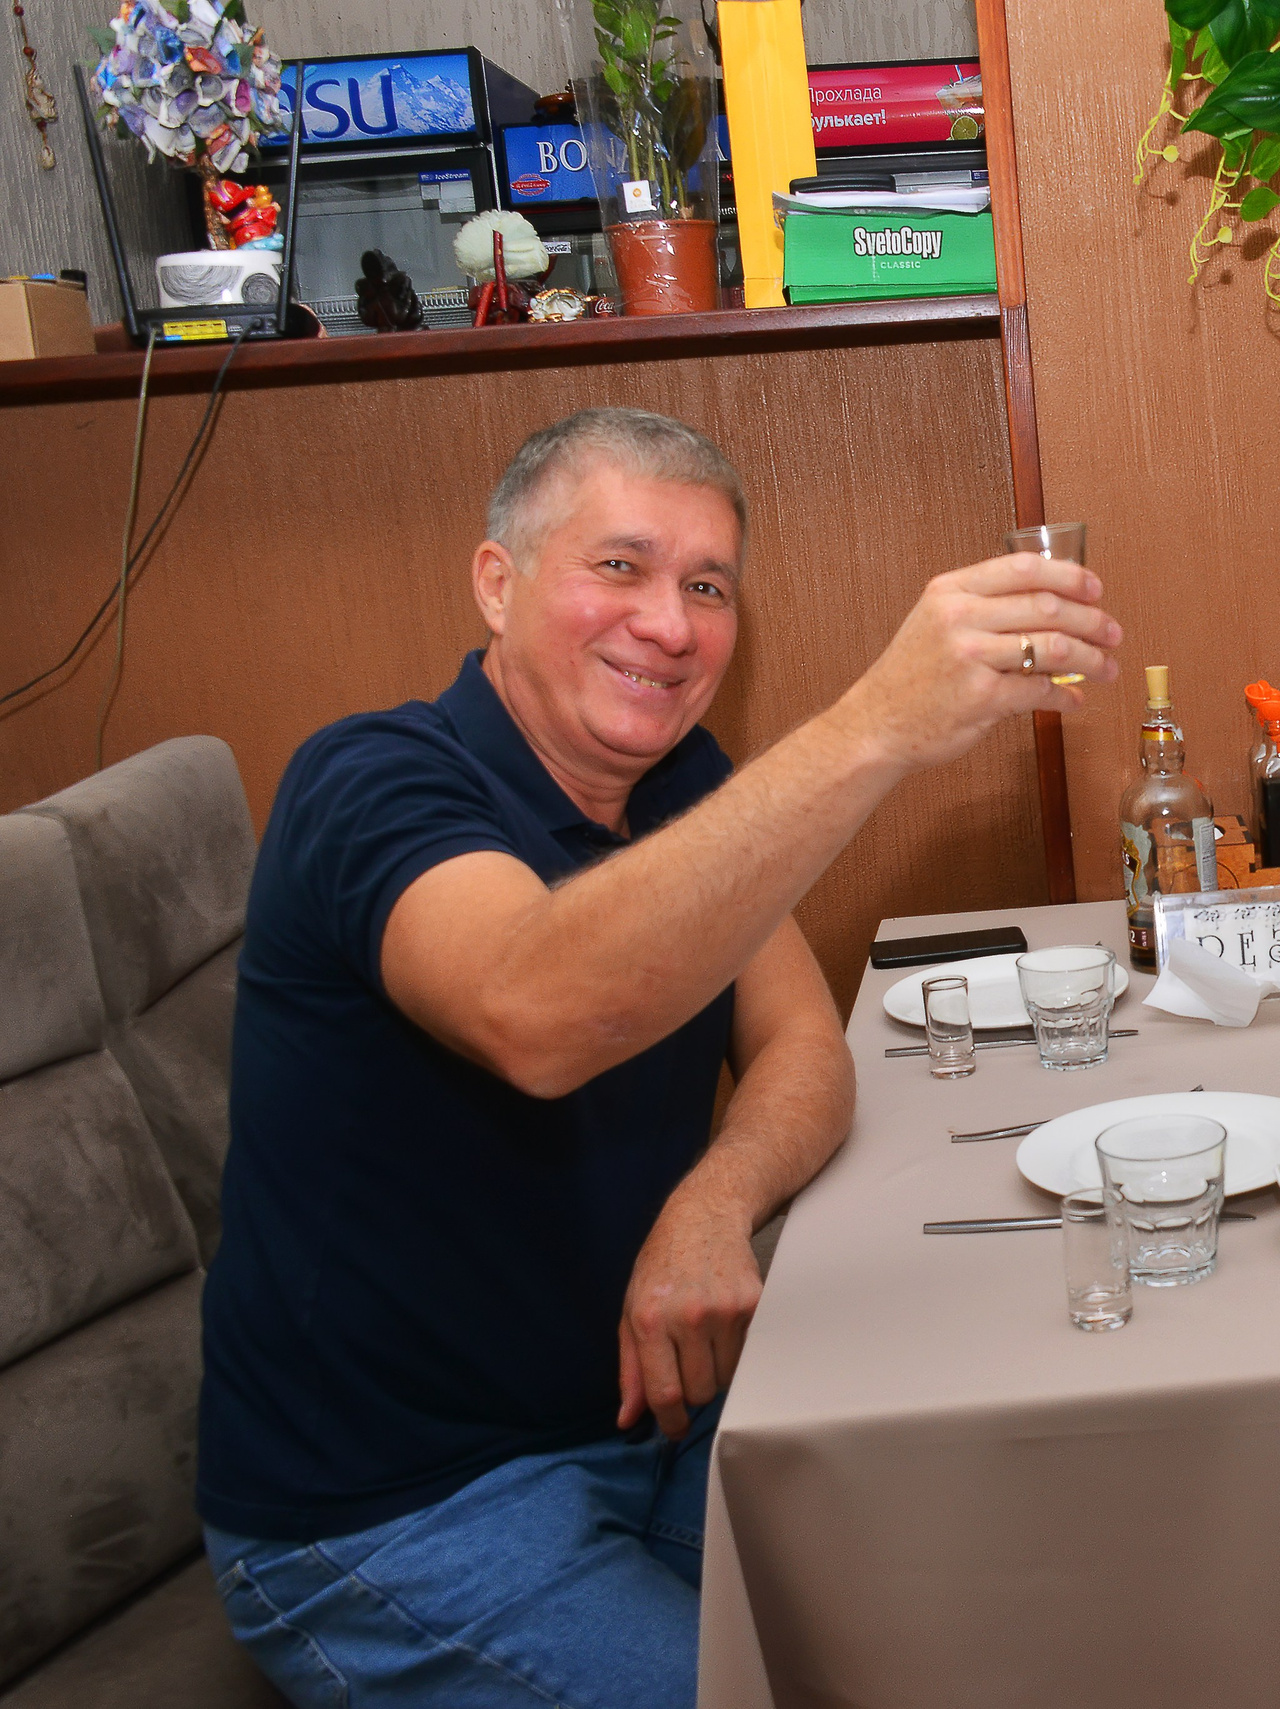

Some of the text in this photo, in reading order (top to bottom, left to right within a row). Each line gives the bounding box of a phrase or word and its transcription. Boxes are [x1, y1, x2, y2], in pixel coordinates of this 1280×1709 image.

[808, 87, 882, 106] Прохлада
[853, 226, 943, 259] SvetoCopy
[880, 261, 921, 269] CLASSIC
